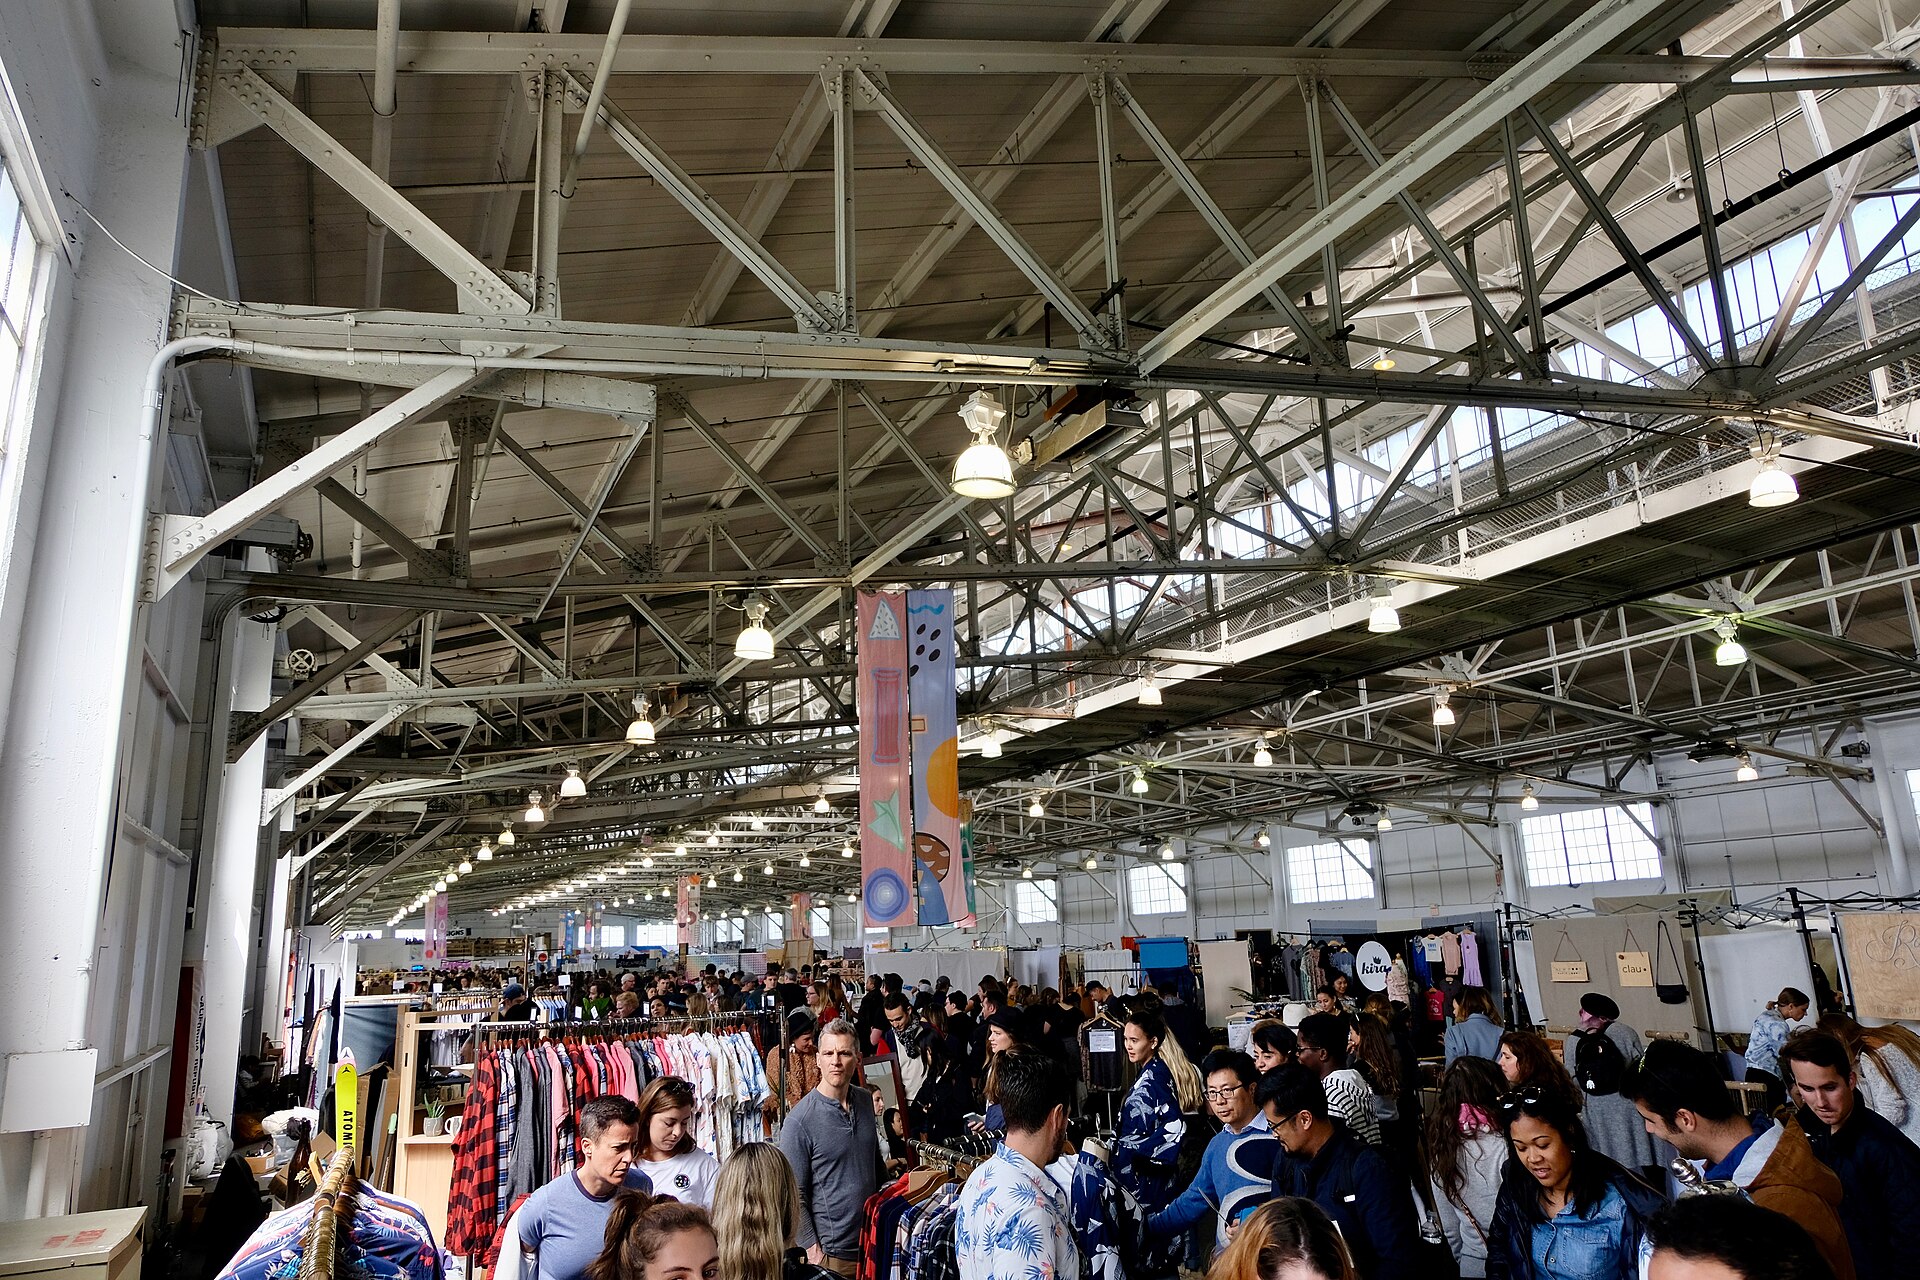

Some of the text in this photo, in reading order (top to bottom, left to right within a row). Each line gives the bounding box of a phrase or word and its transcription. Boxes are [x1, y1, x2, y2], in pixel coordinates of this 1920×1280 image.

[1362, 962, 1391, 975] kira
[189, 995, 205, 1107] CALIFORNIA REPUBLIC
[343, 1110, 353, 1146] ATOMI
